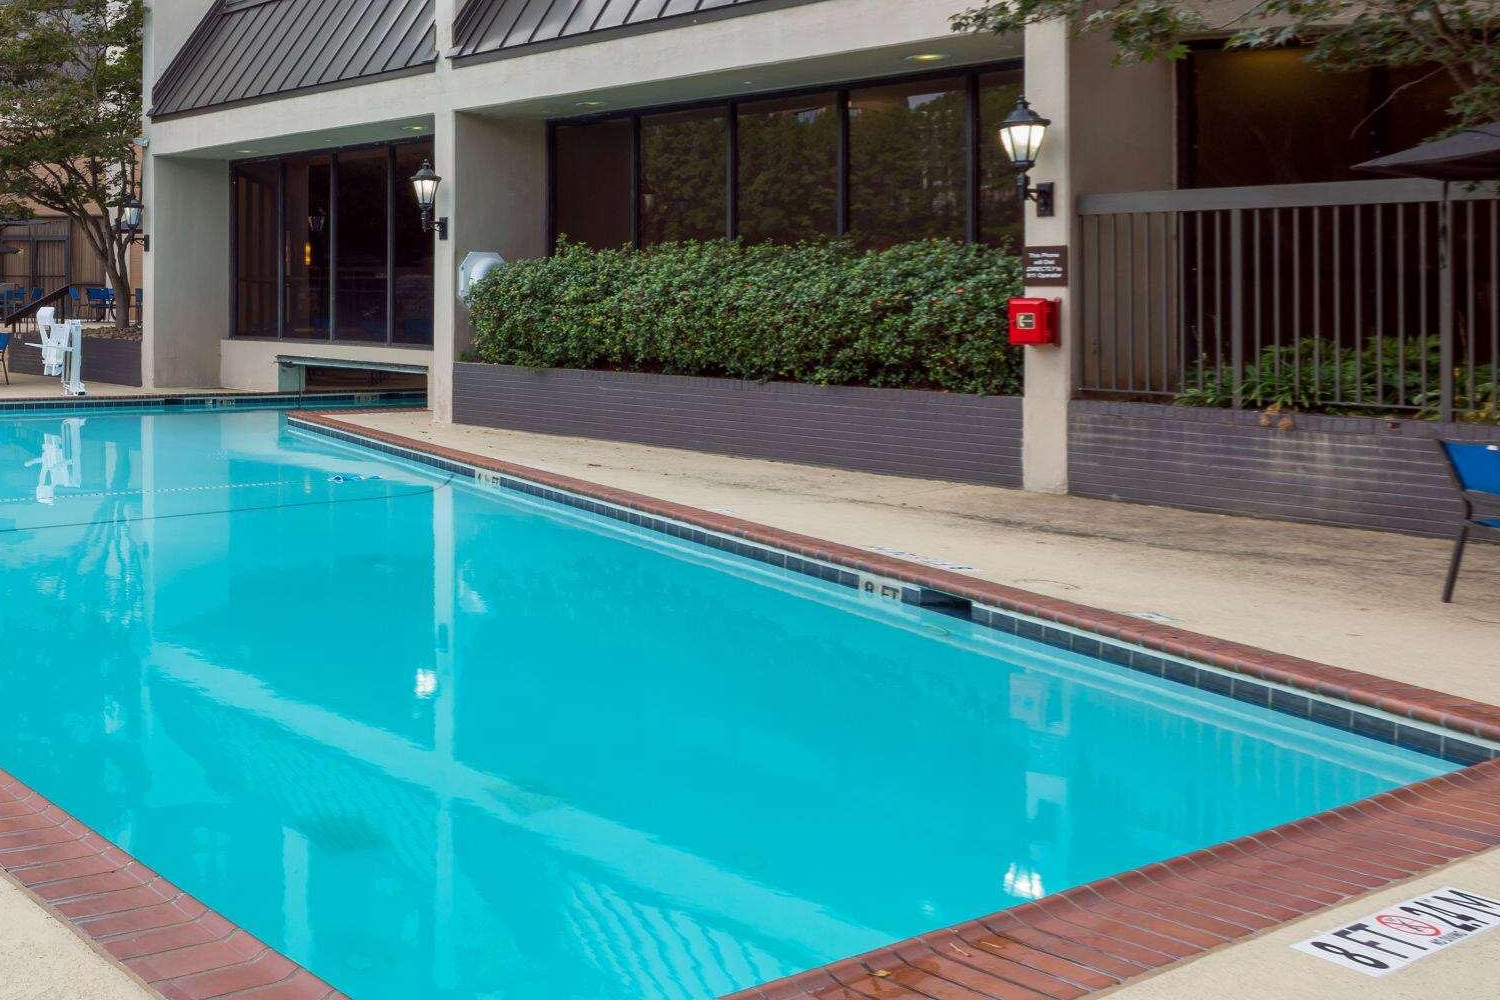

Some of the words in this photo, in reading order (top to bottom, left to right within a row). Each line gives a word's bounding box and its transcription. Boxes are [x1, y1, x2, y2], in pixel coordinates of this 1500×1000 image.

[1398, 901, 1490, 933] 2.4
[1432, 889, 1500, 917] M
[1310, 941, 1390, 969] 8
[1332, 923, 1428, 959] FT
